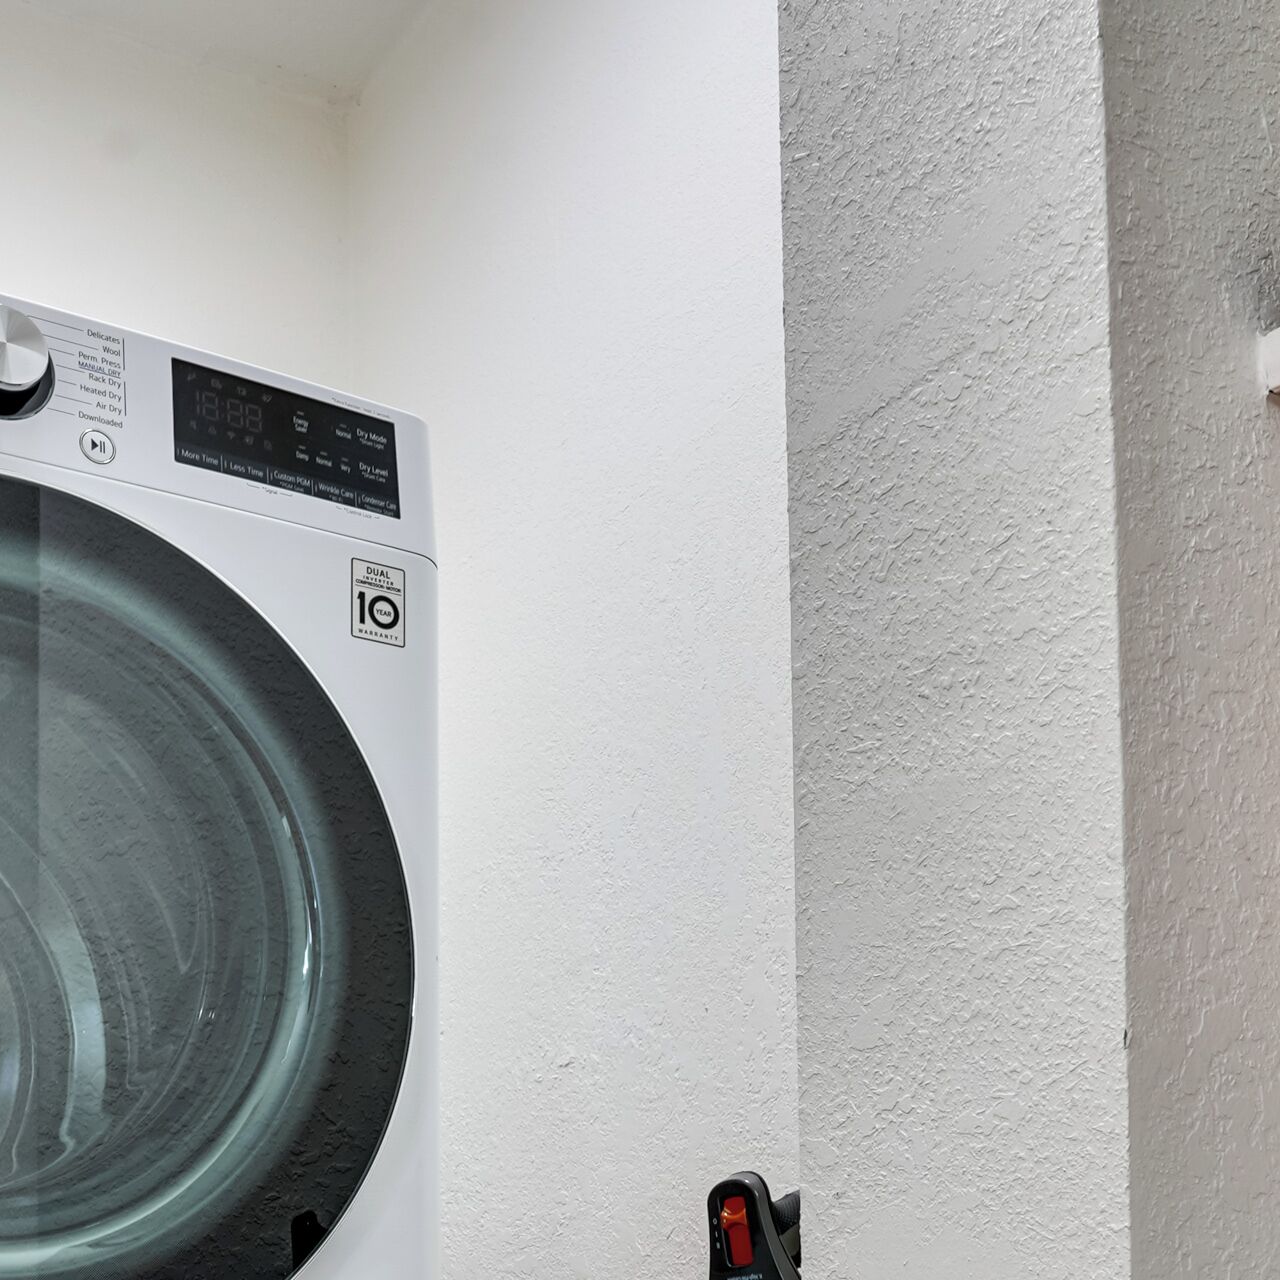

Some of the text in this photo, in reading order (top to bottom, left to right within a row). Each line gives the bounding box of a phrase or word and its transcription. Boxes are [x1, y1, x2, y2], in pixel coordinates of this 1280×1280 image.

[87, 328, 121, 345] Delicates
[102, 345, 121, 357] Wool
[78, 360, 121, 378] MANUAL DRY
[101, 357, 121, 369] Press
[88, 372, 122, 389] Rack Dry
[80, 384, 122, 402] Heated Dry
[96, 401, 122, 415] Air Dry
[78, 410, 123, 429] Downloaded
[335, 428, 352, 440] Normal
[356, 427, 388, 445] Dry Mode
[181, 448, 219, 466] More Time
[315, 456, 333, 467] Normal
[229, 461, 264, 478] Less Time
[340, 463, 351, 474] Very
[359, 462, 389, 477] Dry Level
[273, 470, 311, 488] Custom PGM
[319, 483, 340, 494] Wrinkle
[340, 488, 354, 499] Care
[385, 500, 397, 511] Care
[366, 566, 391, 580] DUAL
[362, 575, 395, 587] INVERTER
[356, 590, 400, 630] 10 YEAR
[358, 628, 399, 641] WARRANTY
